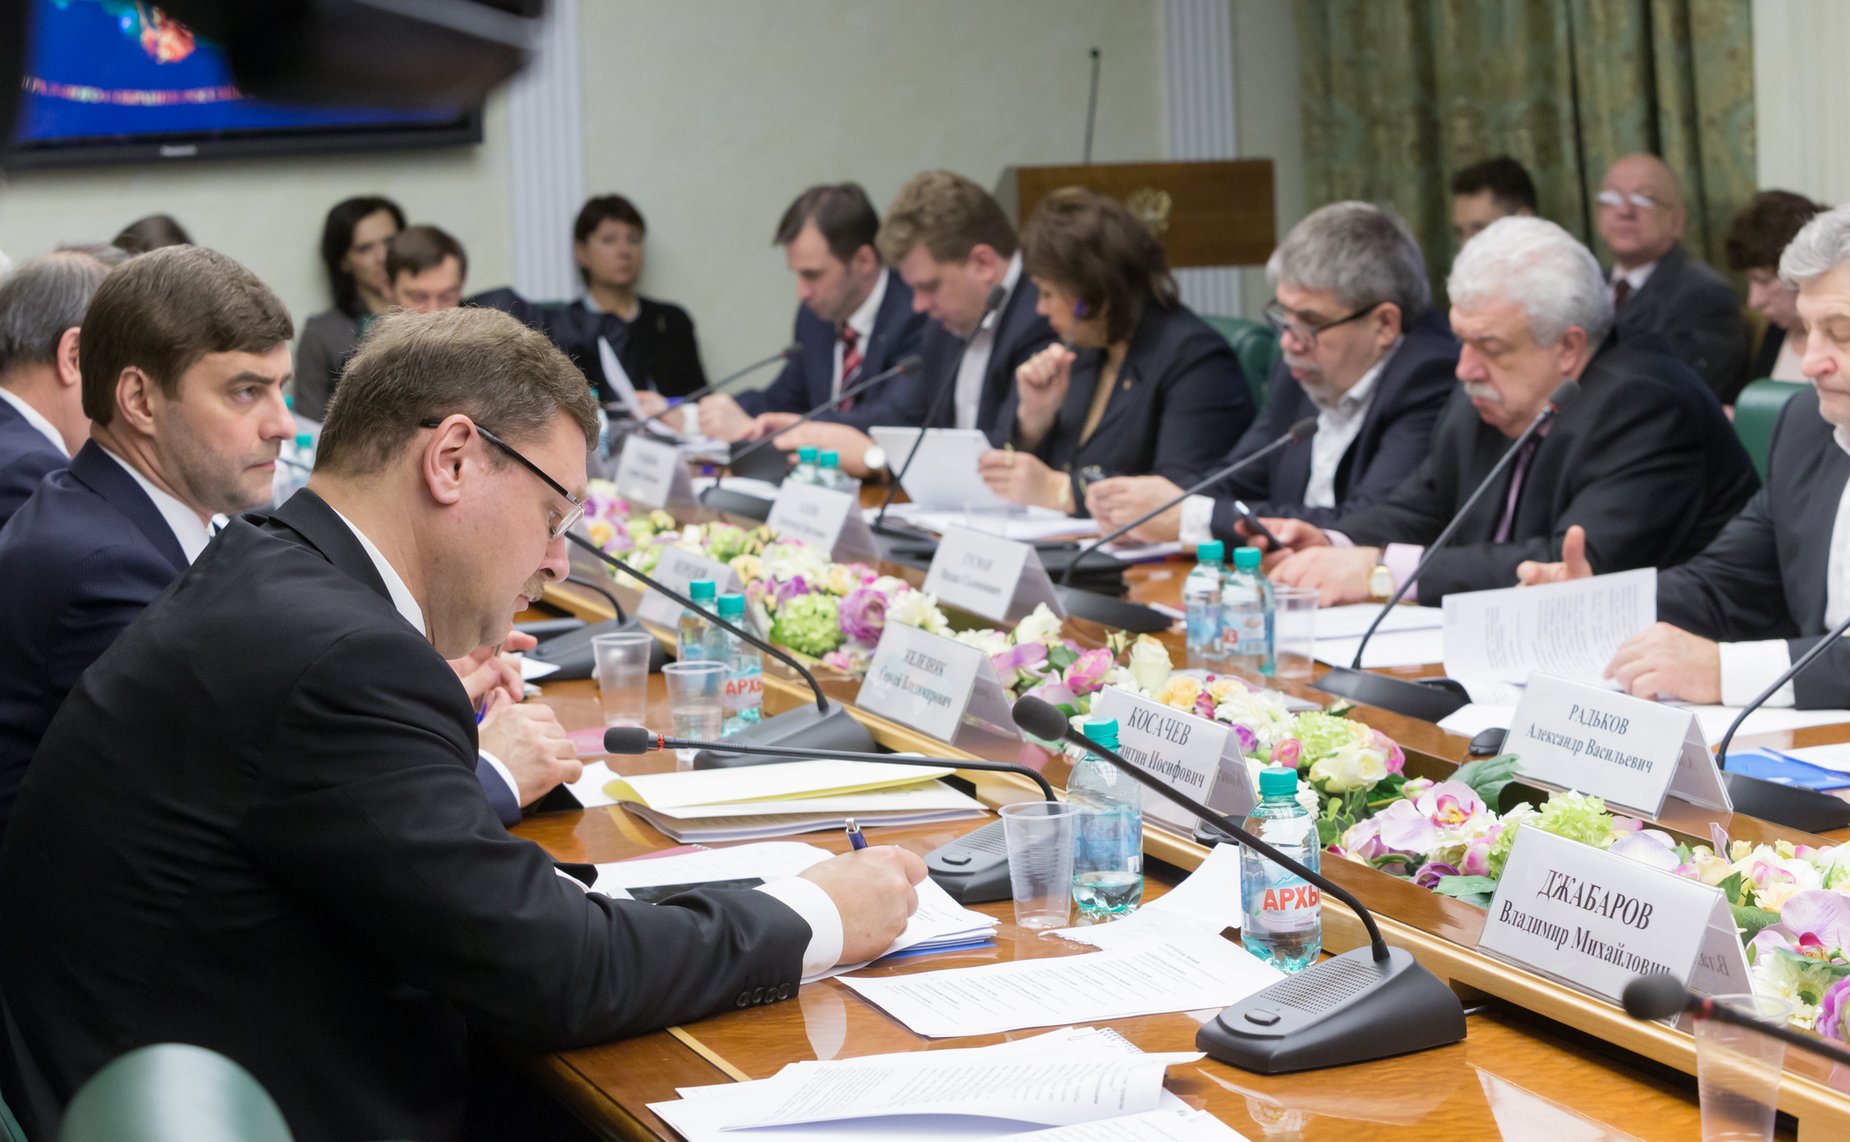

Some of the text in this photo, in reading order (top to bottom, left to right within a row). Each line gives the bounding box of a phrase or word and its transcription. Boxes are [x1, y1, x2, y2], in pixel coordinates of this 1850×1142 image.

[1127, 706, 1192, 746] КОСАЧЕВ
[1568, 703, 1630, 735] РАДЬКОВ
[1119, 744, 1147, 767] антин
[1148, 750, 1206, 789] Иосифович
[1525, 722, 1653, 774] Александр Васильевич
[1535, 868, 1654, 931] ДЖАБАРОВ
[1498, 899, 1570, 951] Владимир
